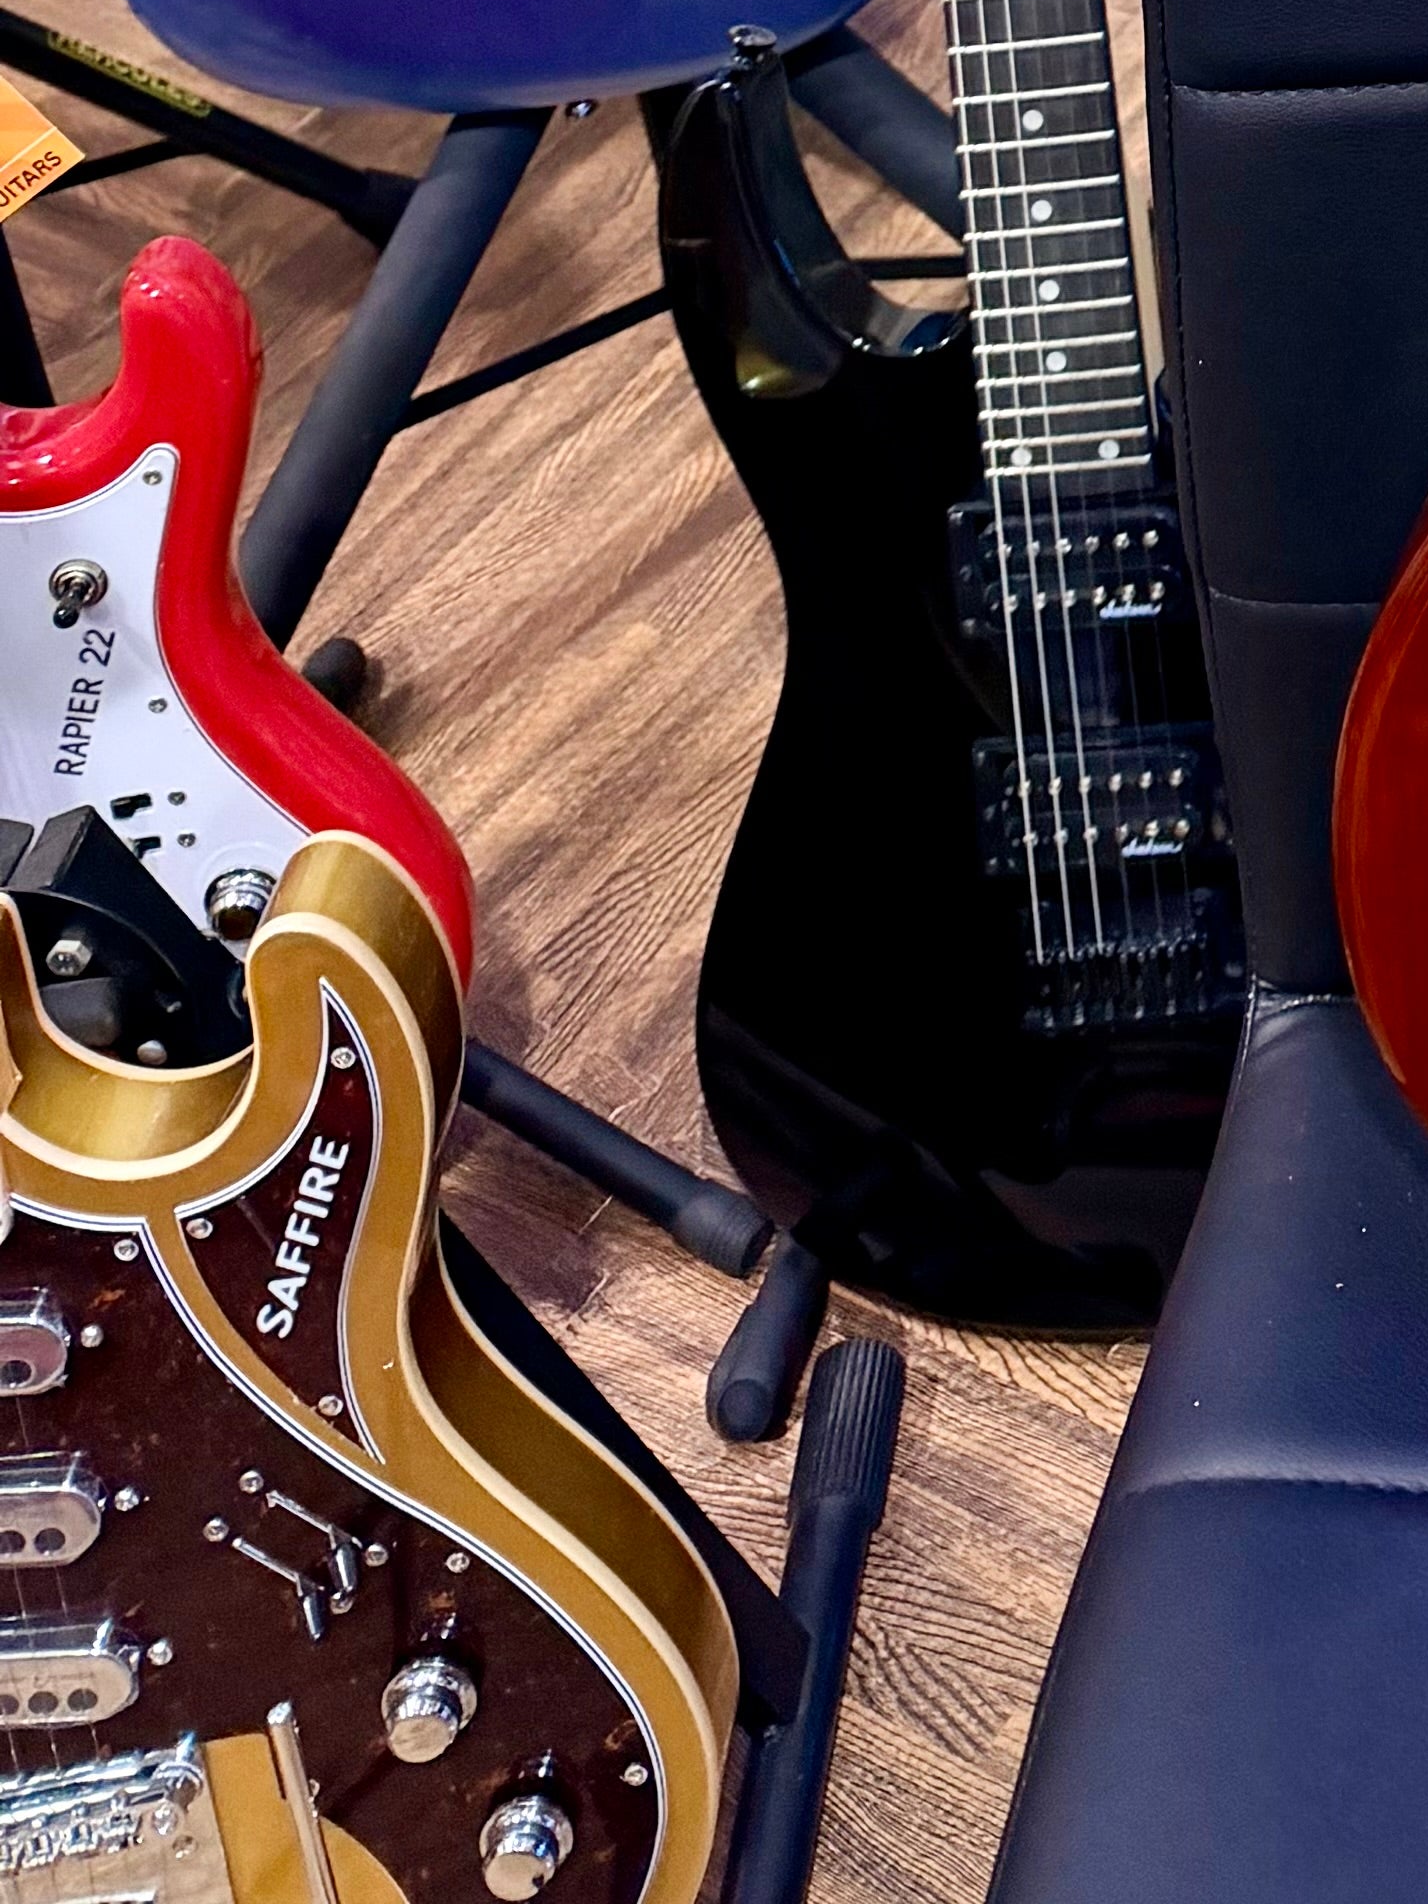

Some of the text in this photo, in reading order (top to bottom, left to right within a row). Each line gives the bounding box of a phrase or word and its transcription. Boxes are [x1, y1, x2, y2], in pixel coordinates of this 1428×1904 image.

[53, 629, 116, 776] RAPIER 22
[256, 1135, 349, 1339] SAFFIRE
